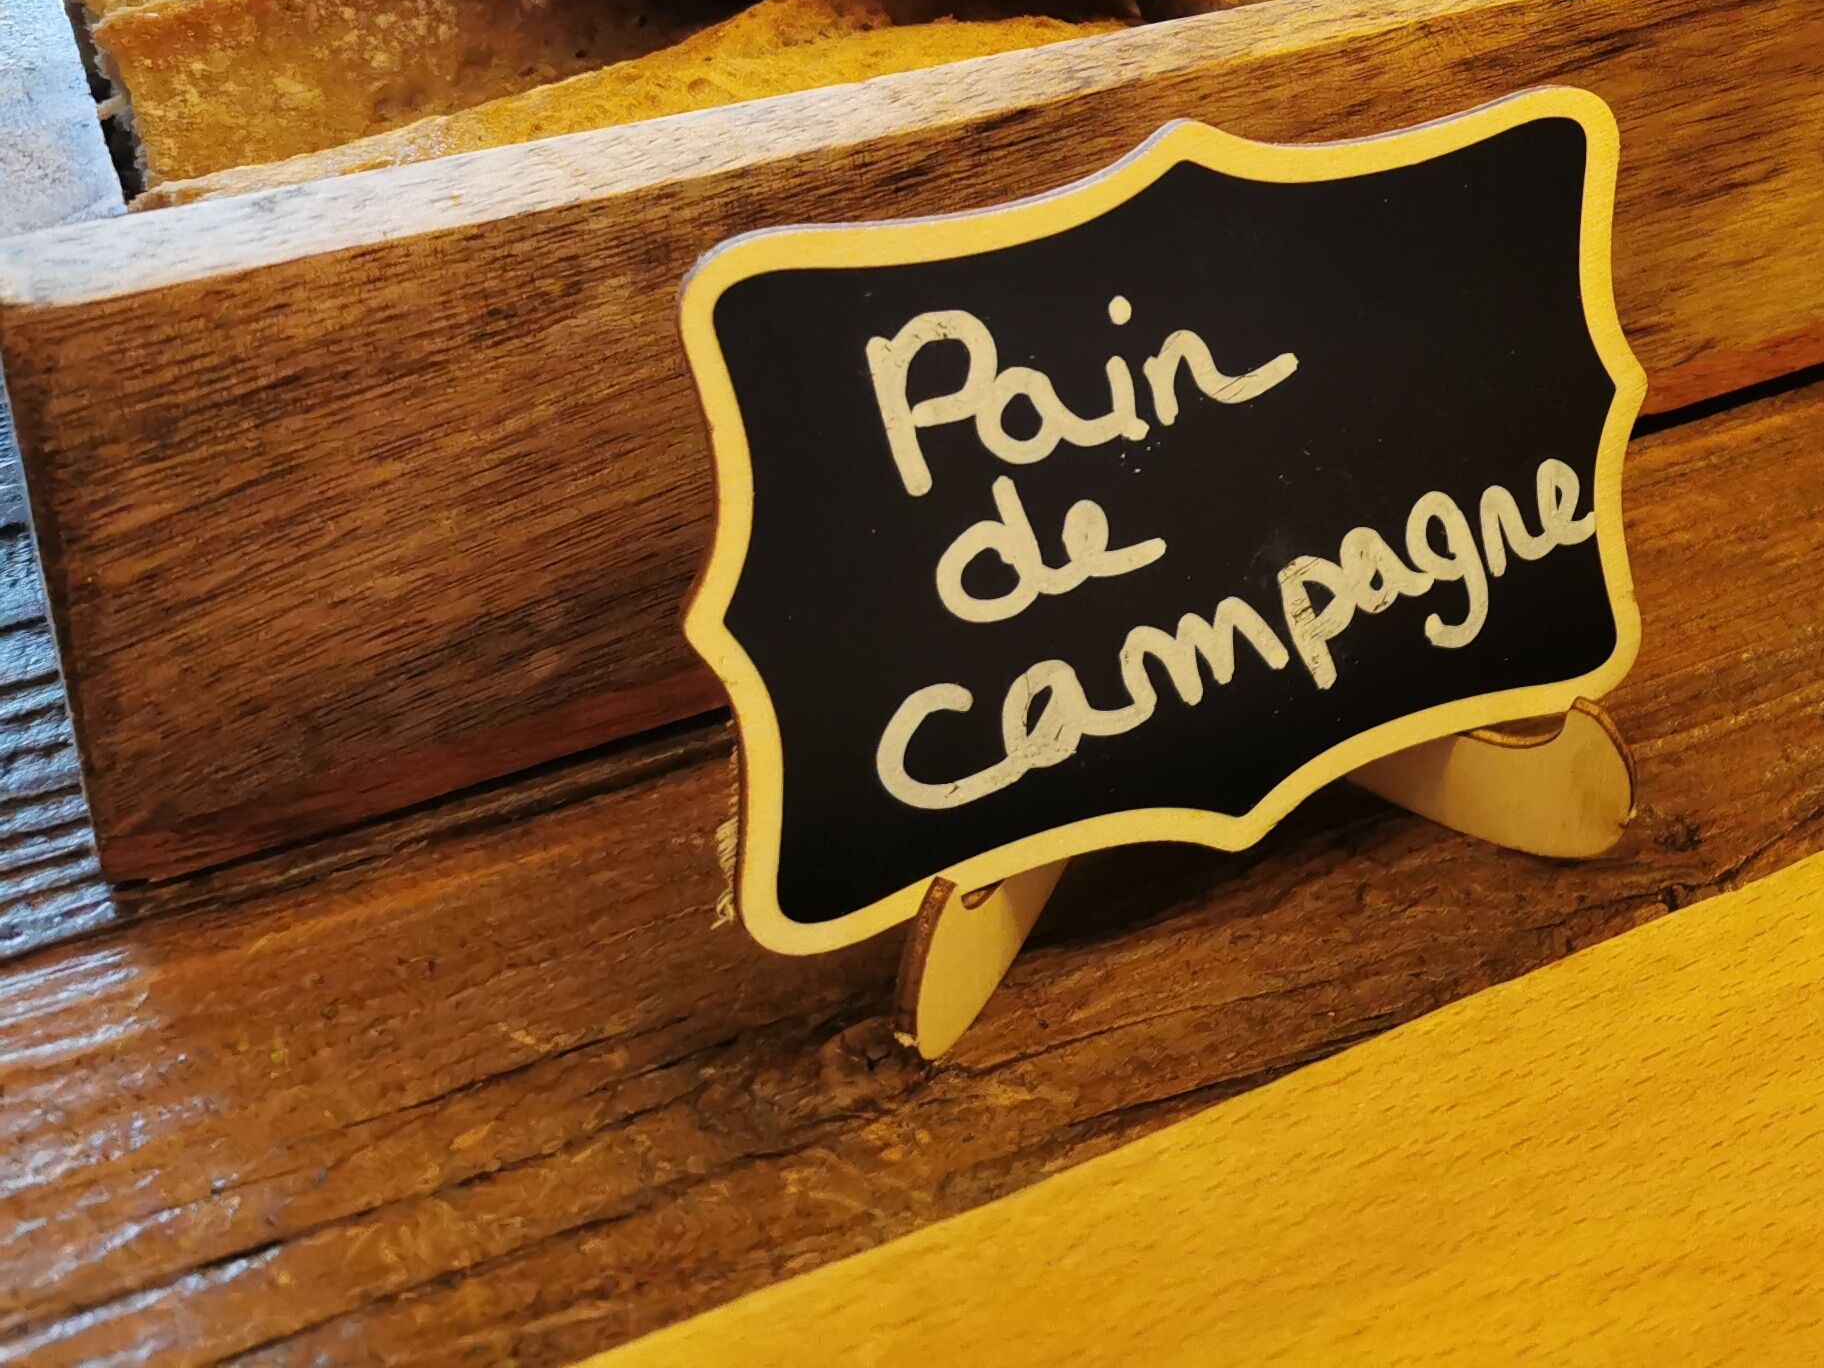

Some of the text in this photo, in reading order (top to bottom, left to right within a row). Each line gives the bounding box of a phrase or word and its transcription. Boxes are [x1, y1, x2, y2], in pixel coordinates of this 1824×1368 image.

[865, 295, 1300, 497] Pain
[875, 458, 1597, 811] campagne
[935, 475, 1168, 624] de
